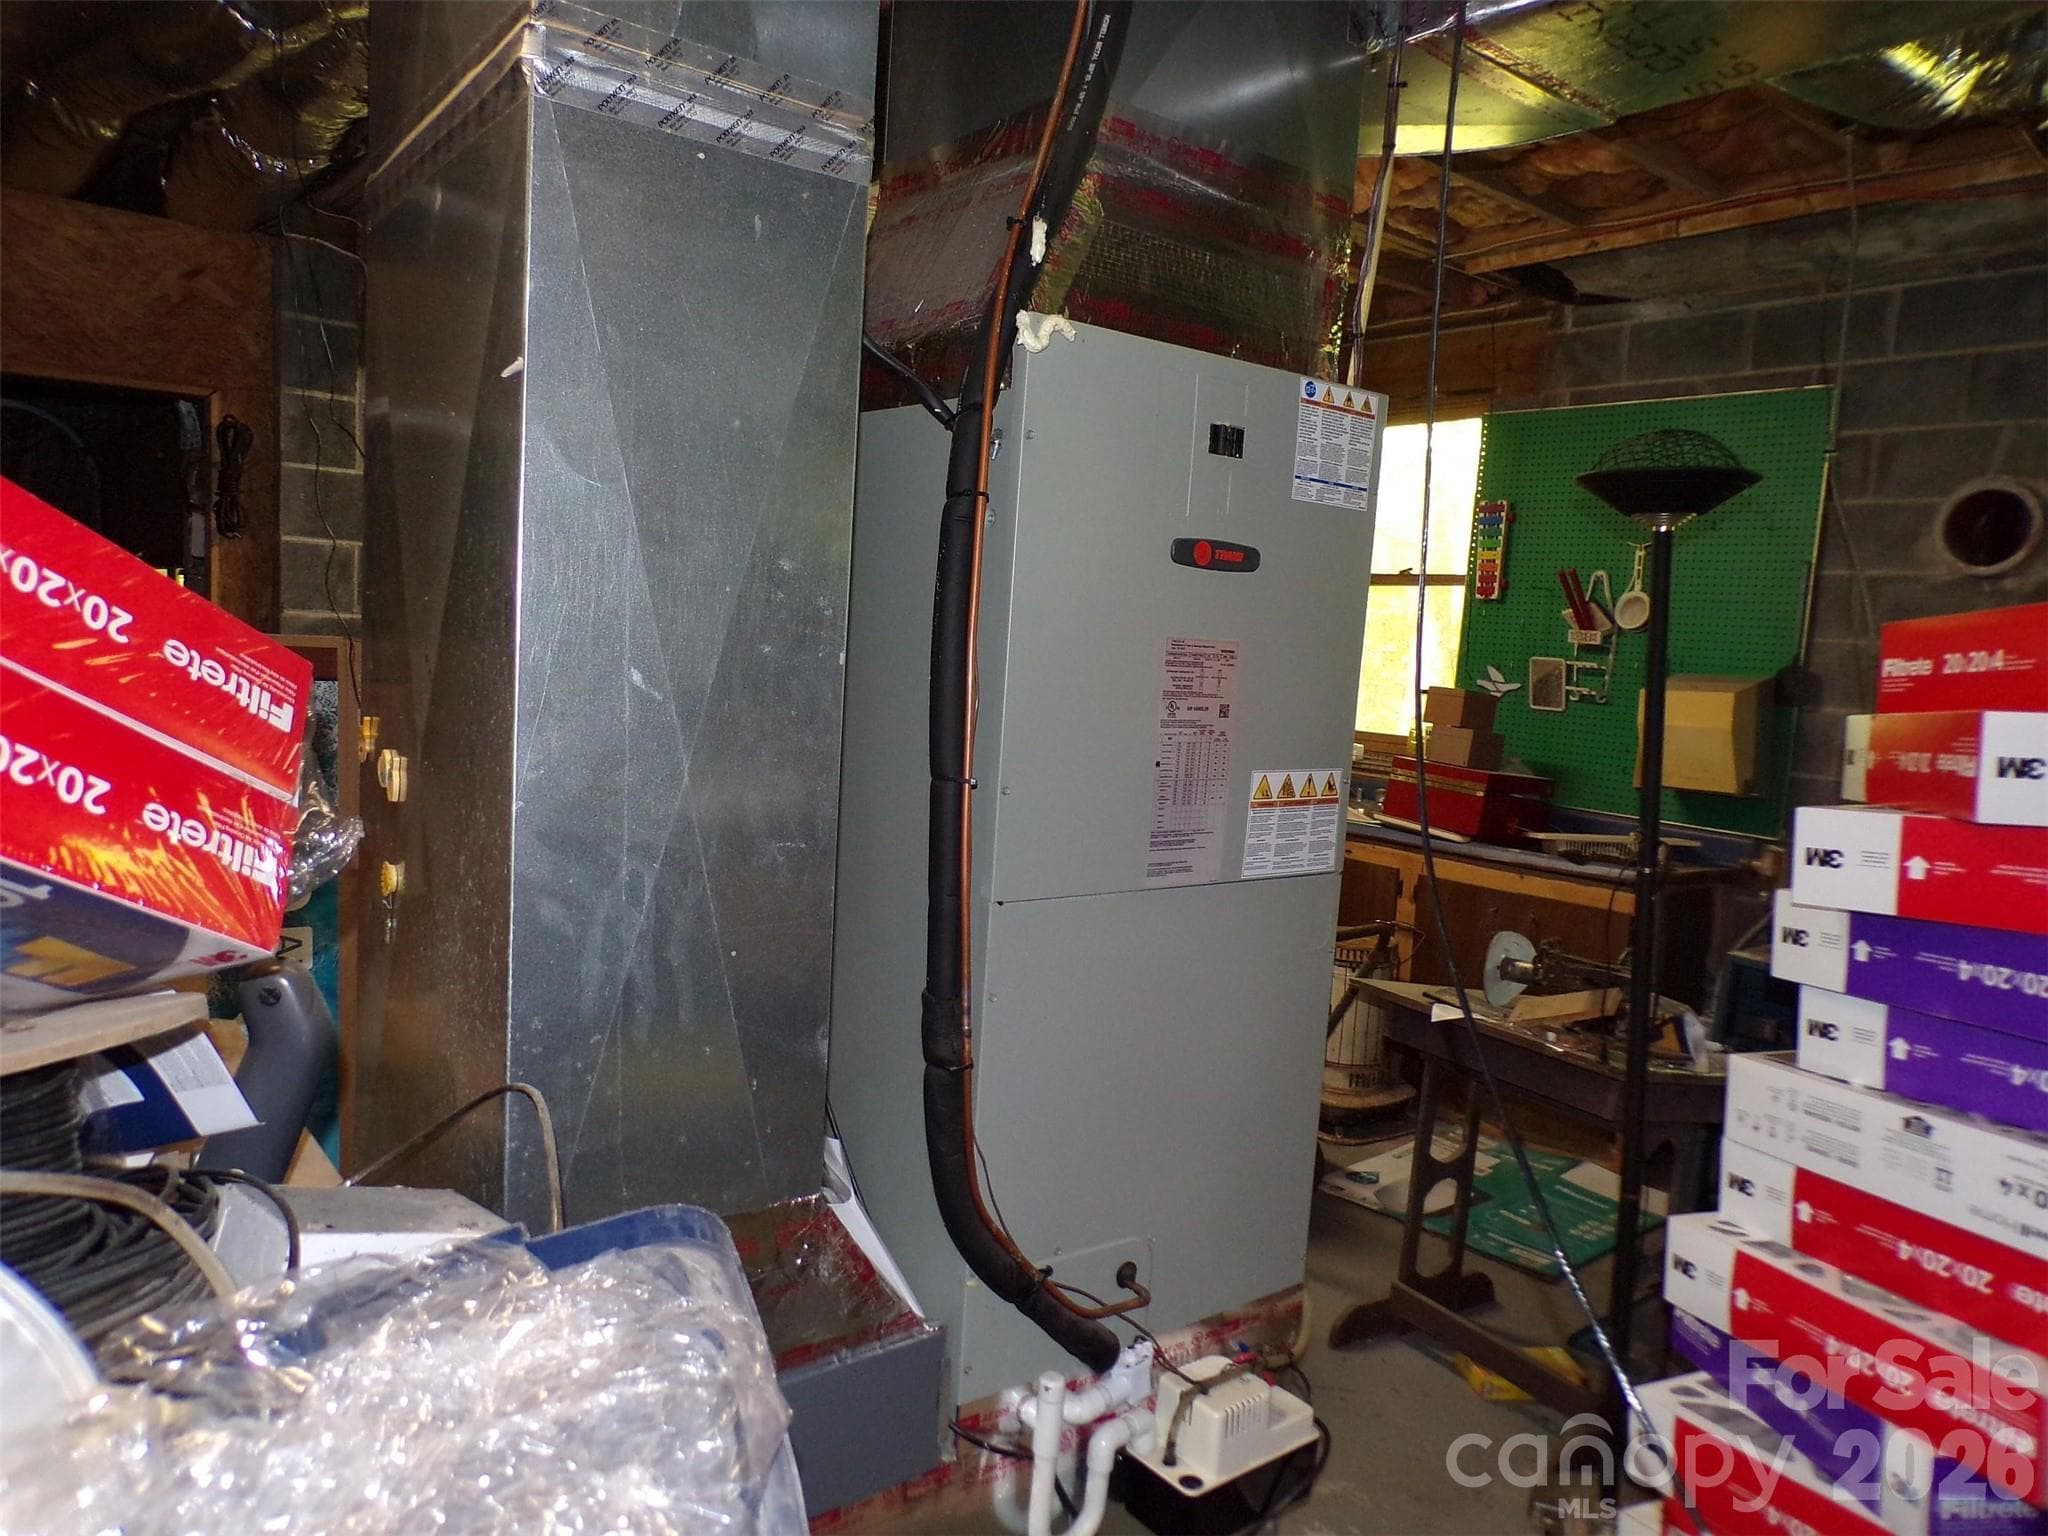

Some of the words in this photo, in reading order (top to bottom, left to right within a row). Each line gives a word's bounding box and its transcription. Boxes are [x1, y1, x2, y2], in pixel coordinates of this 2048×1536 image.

[163, 639, 294, 734] Filtrete
[1997, 756, 2047, 780] 3M
[142, 802, 279, 899] Filtrete
[1805, 847, 1844, 869] 3M
[1781, 926, 1809, 947] 3M
[1808, 1018, 1840, 1041] 3M
[1728, 1172, 1755, 1197] 3M
